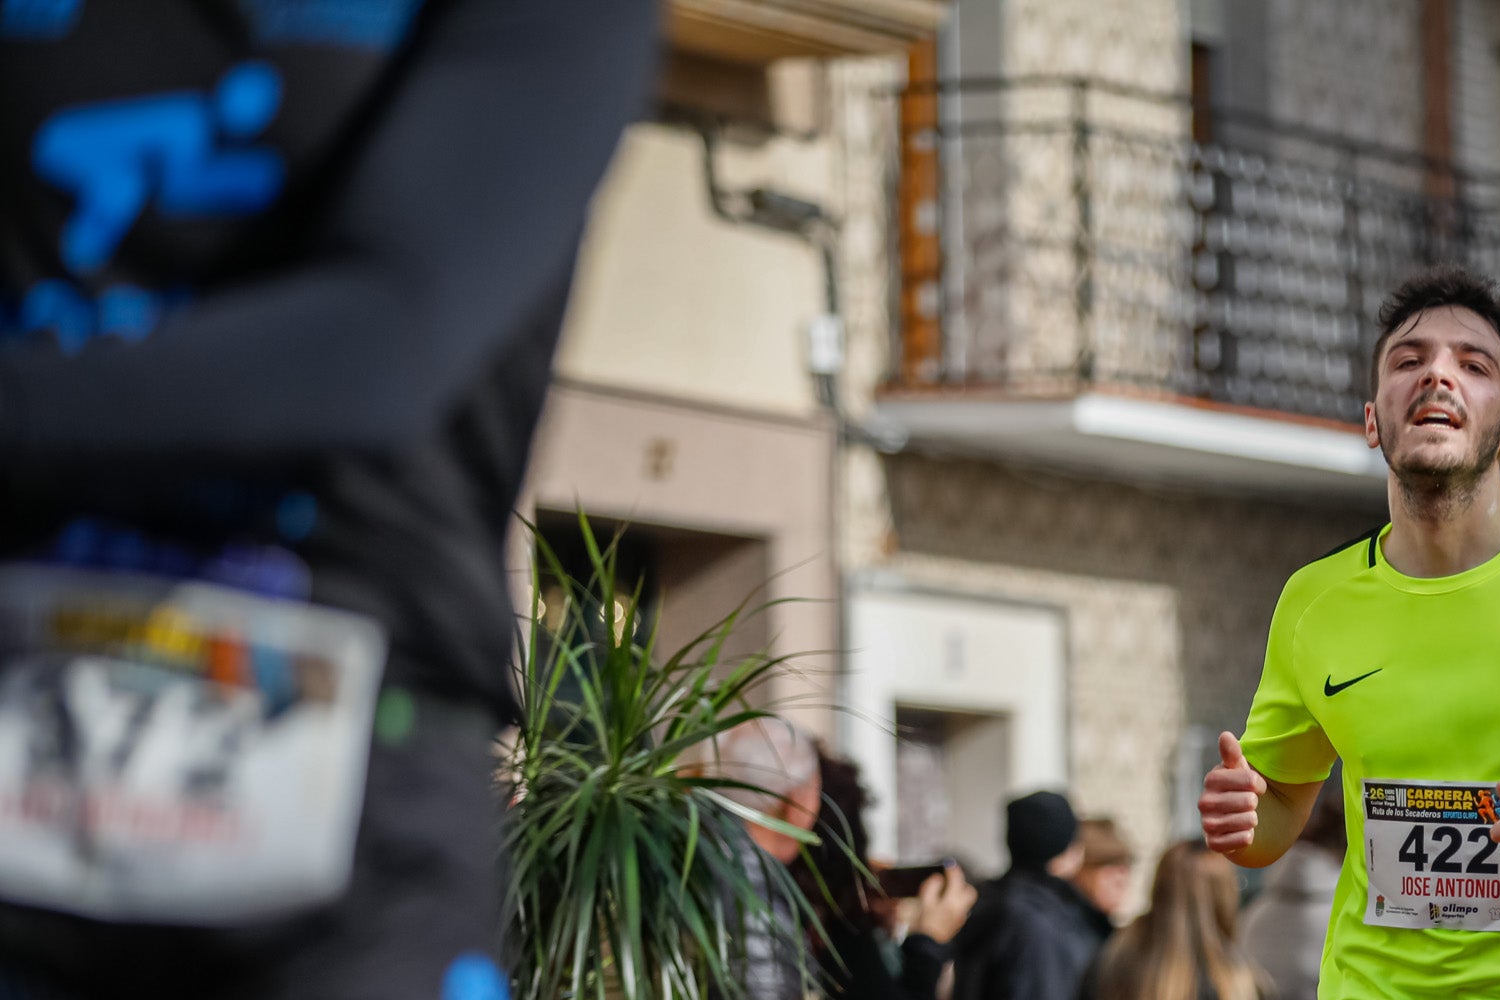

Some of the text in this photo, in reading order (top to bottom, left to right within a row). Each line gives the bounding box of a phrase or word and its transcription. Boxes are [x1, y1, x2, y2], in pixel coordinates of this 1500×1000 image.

[1370, 788, 1384, 800] 26
[1407, 788, 1472, 801] CARRERA
[1408, 800, 1472, 810] POPULAR
[1372, 807, 1441, 818] Ruta de los Secaderos
[1398, 825, 1498, 874] 422
[1401, 876, 1500, 899] JOSE ANTONIO
[1442, 904, 1478, 915] olimpo
